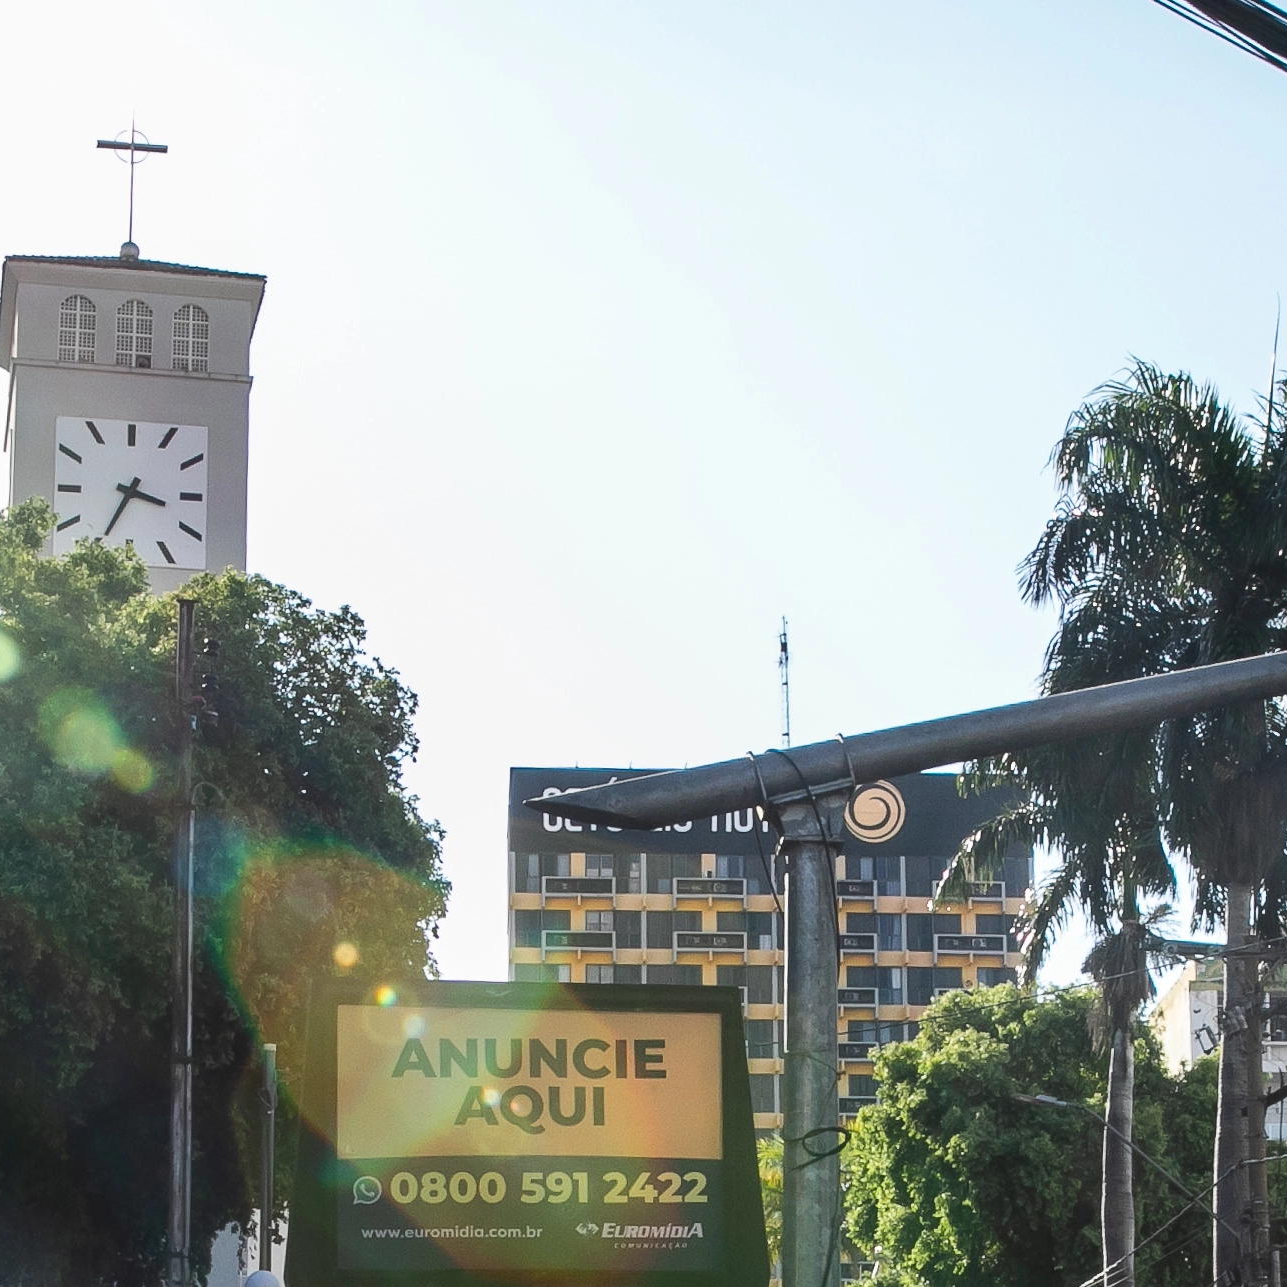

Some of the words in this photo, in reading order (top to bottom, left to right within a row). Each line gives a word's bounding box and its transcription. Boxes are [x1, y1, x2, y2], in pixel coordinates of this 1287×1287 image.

[390, 1037, 667, 1079] ANUNCIE
[454, 1084, 606, 1135] AQUI
[390, 1171, 507, 1204] 0800
[520, 1171, 589, 1204] 591
[602, 1171, 708, 1204] 2422
[361, 1224, 543, 1239] www.euromidia.com.br
